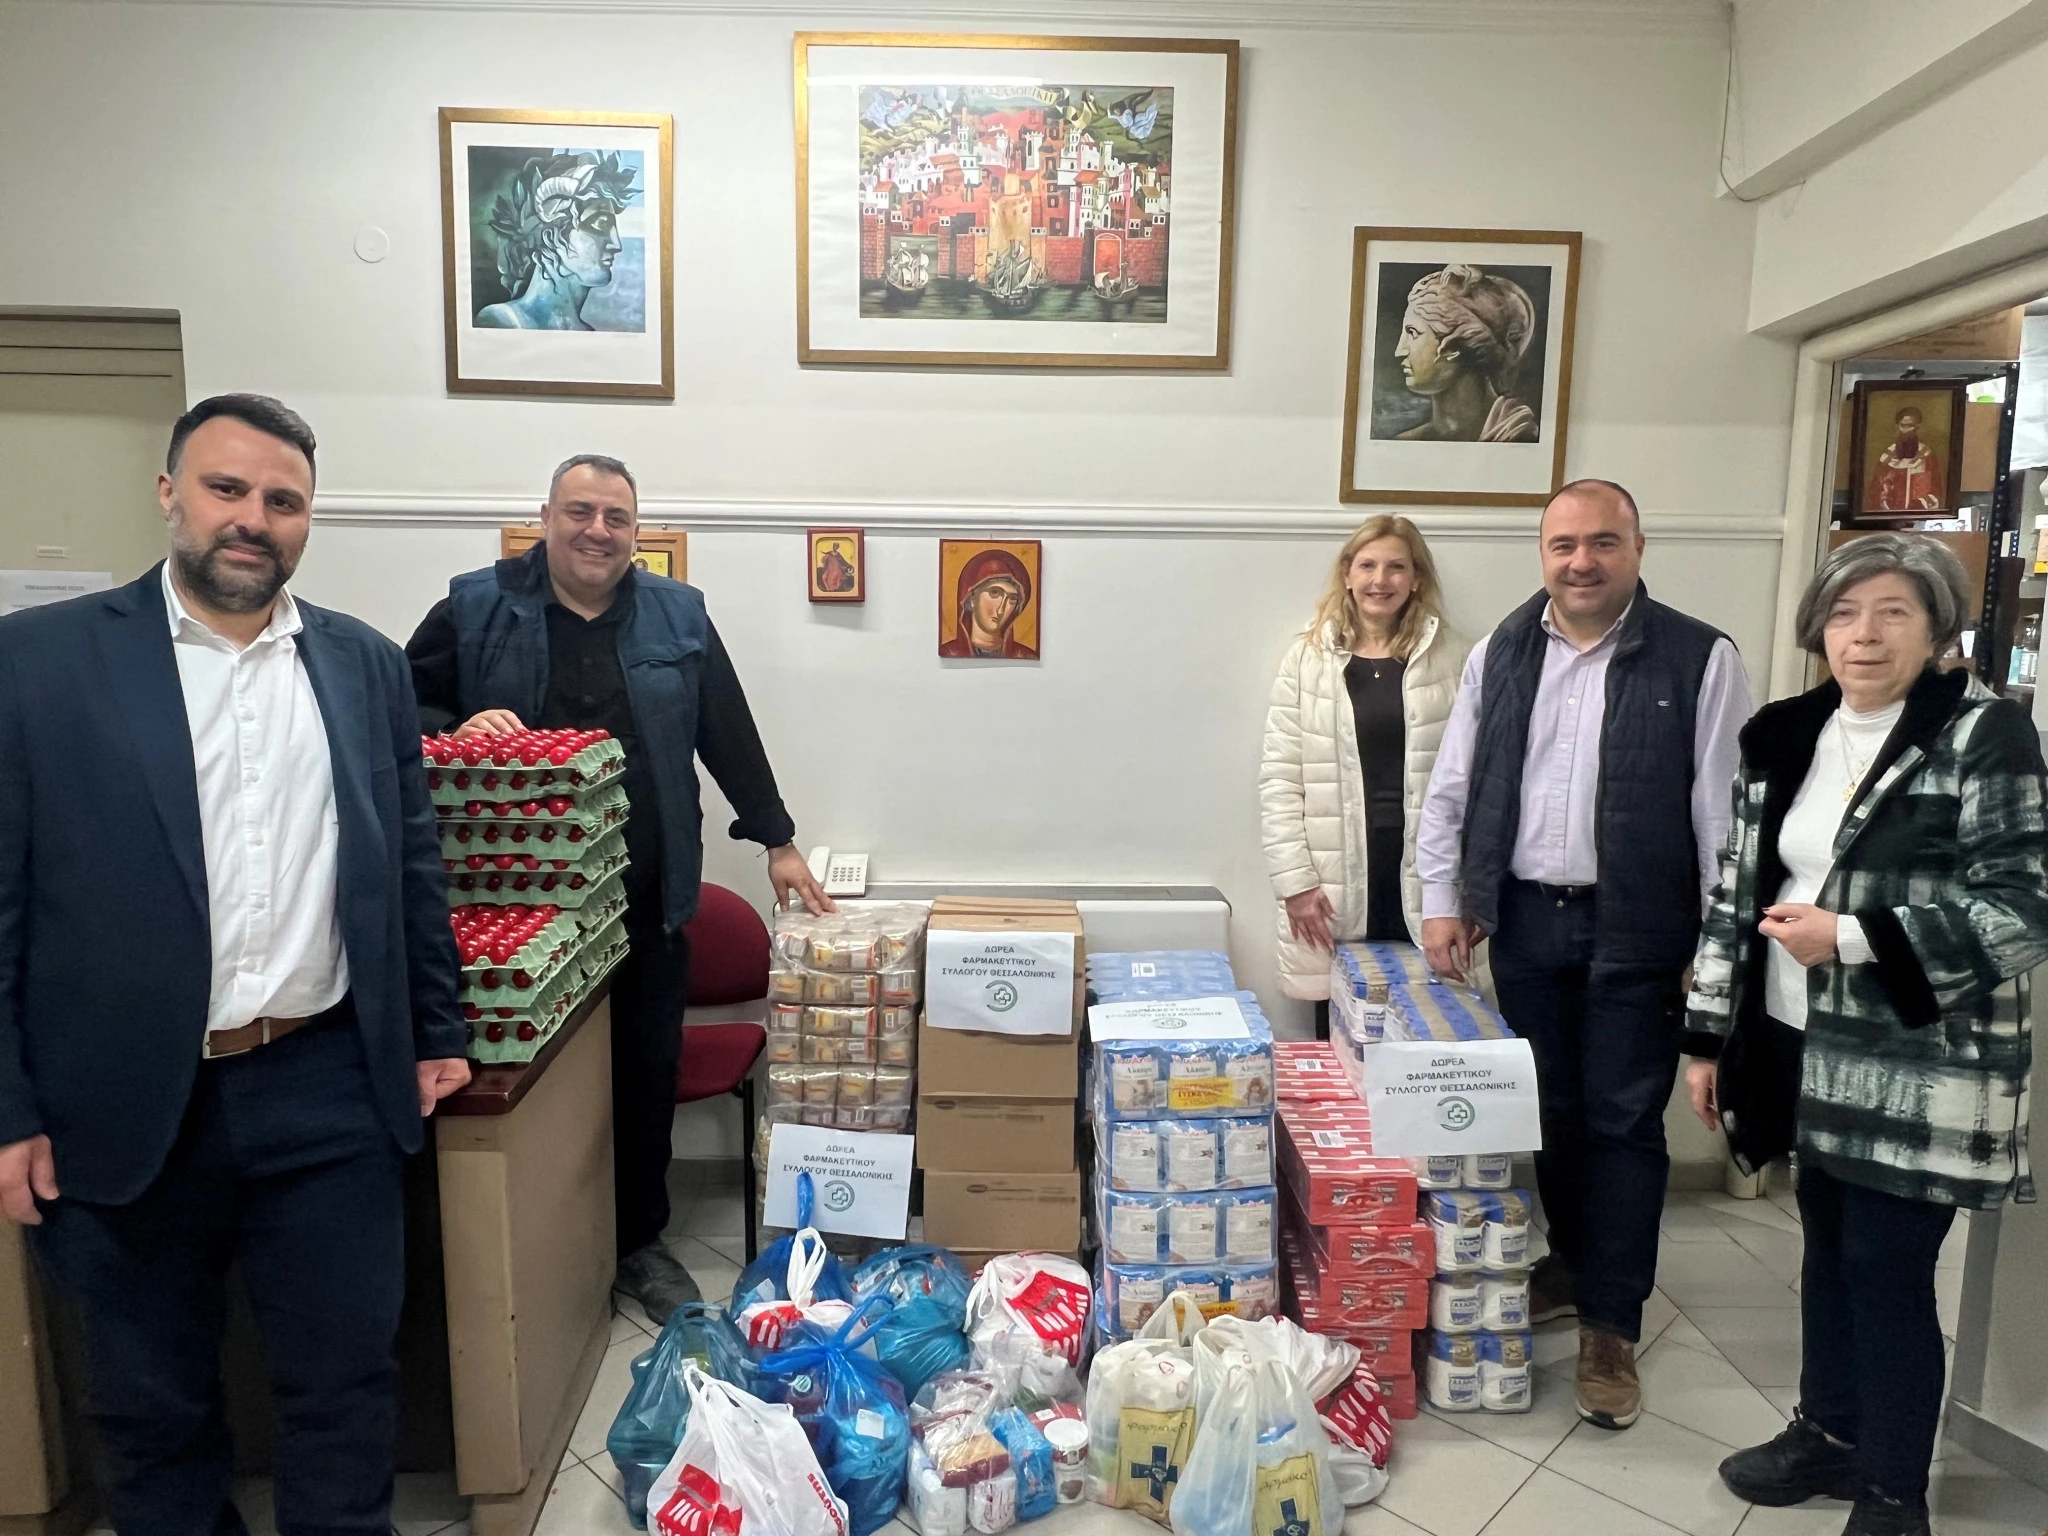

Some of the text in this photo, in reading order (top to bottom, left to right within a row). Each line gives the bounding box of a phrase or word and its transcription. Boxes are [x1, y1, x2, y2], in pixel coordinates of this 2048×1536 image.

[984, 945, 1015, 954] ΔΩΡΕΑ
[962, 957, 1037, 966] ΦΑΡΜΑΚΕΥΤΙΚΟΥ
[942, 968, 1056, 979] ΣΥΛΛΟΓΟΥ ΘΕΣΣΑΛΟΝΙΚΗΣ
[1431, 1057, 1466, 1067] ΔΩΡΕΑ
[1406, 1069, 1492, 1081] ΦΑΡΜΑΚΕΥΤΙΚΟΥ
[1385, 1081, 1517, 1095] ΣΥΛΛΟΓΟΥ ΘΕΣΣΑΛΟΝΙΚΗΣ
[825, 1144, 855, 1154] ΔΩΡΕΑ
[803, 1154, 876, 1166] ΦΑΡΜΑΚΕΥΤΙΚΟΥ
[783, 1164, 894, 1181] ΣΥΛΛΟΓΟΥ ΘΕΣΣΑΛΟΝΙΚΗΣ
